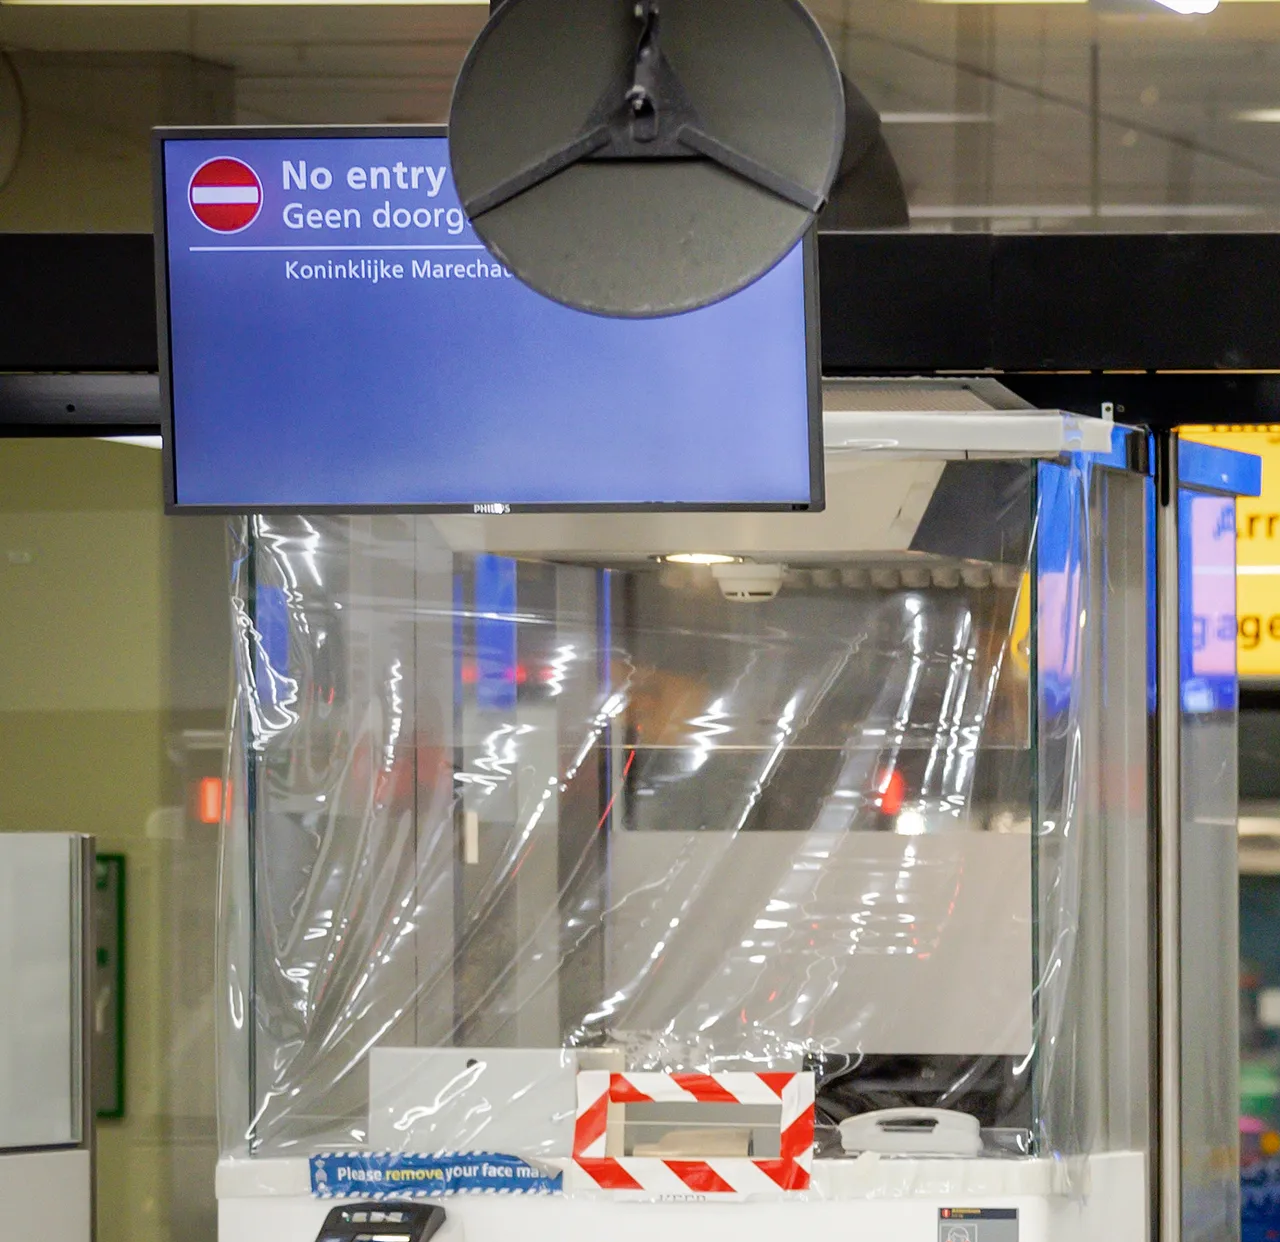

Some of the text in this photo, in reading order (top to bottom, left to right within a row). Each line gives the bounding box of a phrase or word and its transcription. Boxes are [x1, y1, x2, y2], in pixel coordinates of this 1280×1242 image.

[283, 161, 446, 197] No entry
[283, 202, 472, 234] Geen doorg
[286, 259, 403, 283] Koninklijke
[474, 503, 510, 513] PHILS
[338, 1167, 382, 1182] Please
[385, 1169, 444, 1181] remove
[445, 1166, 477, 1182] your
[482, 1164, 512, 1177] face
